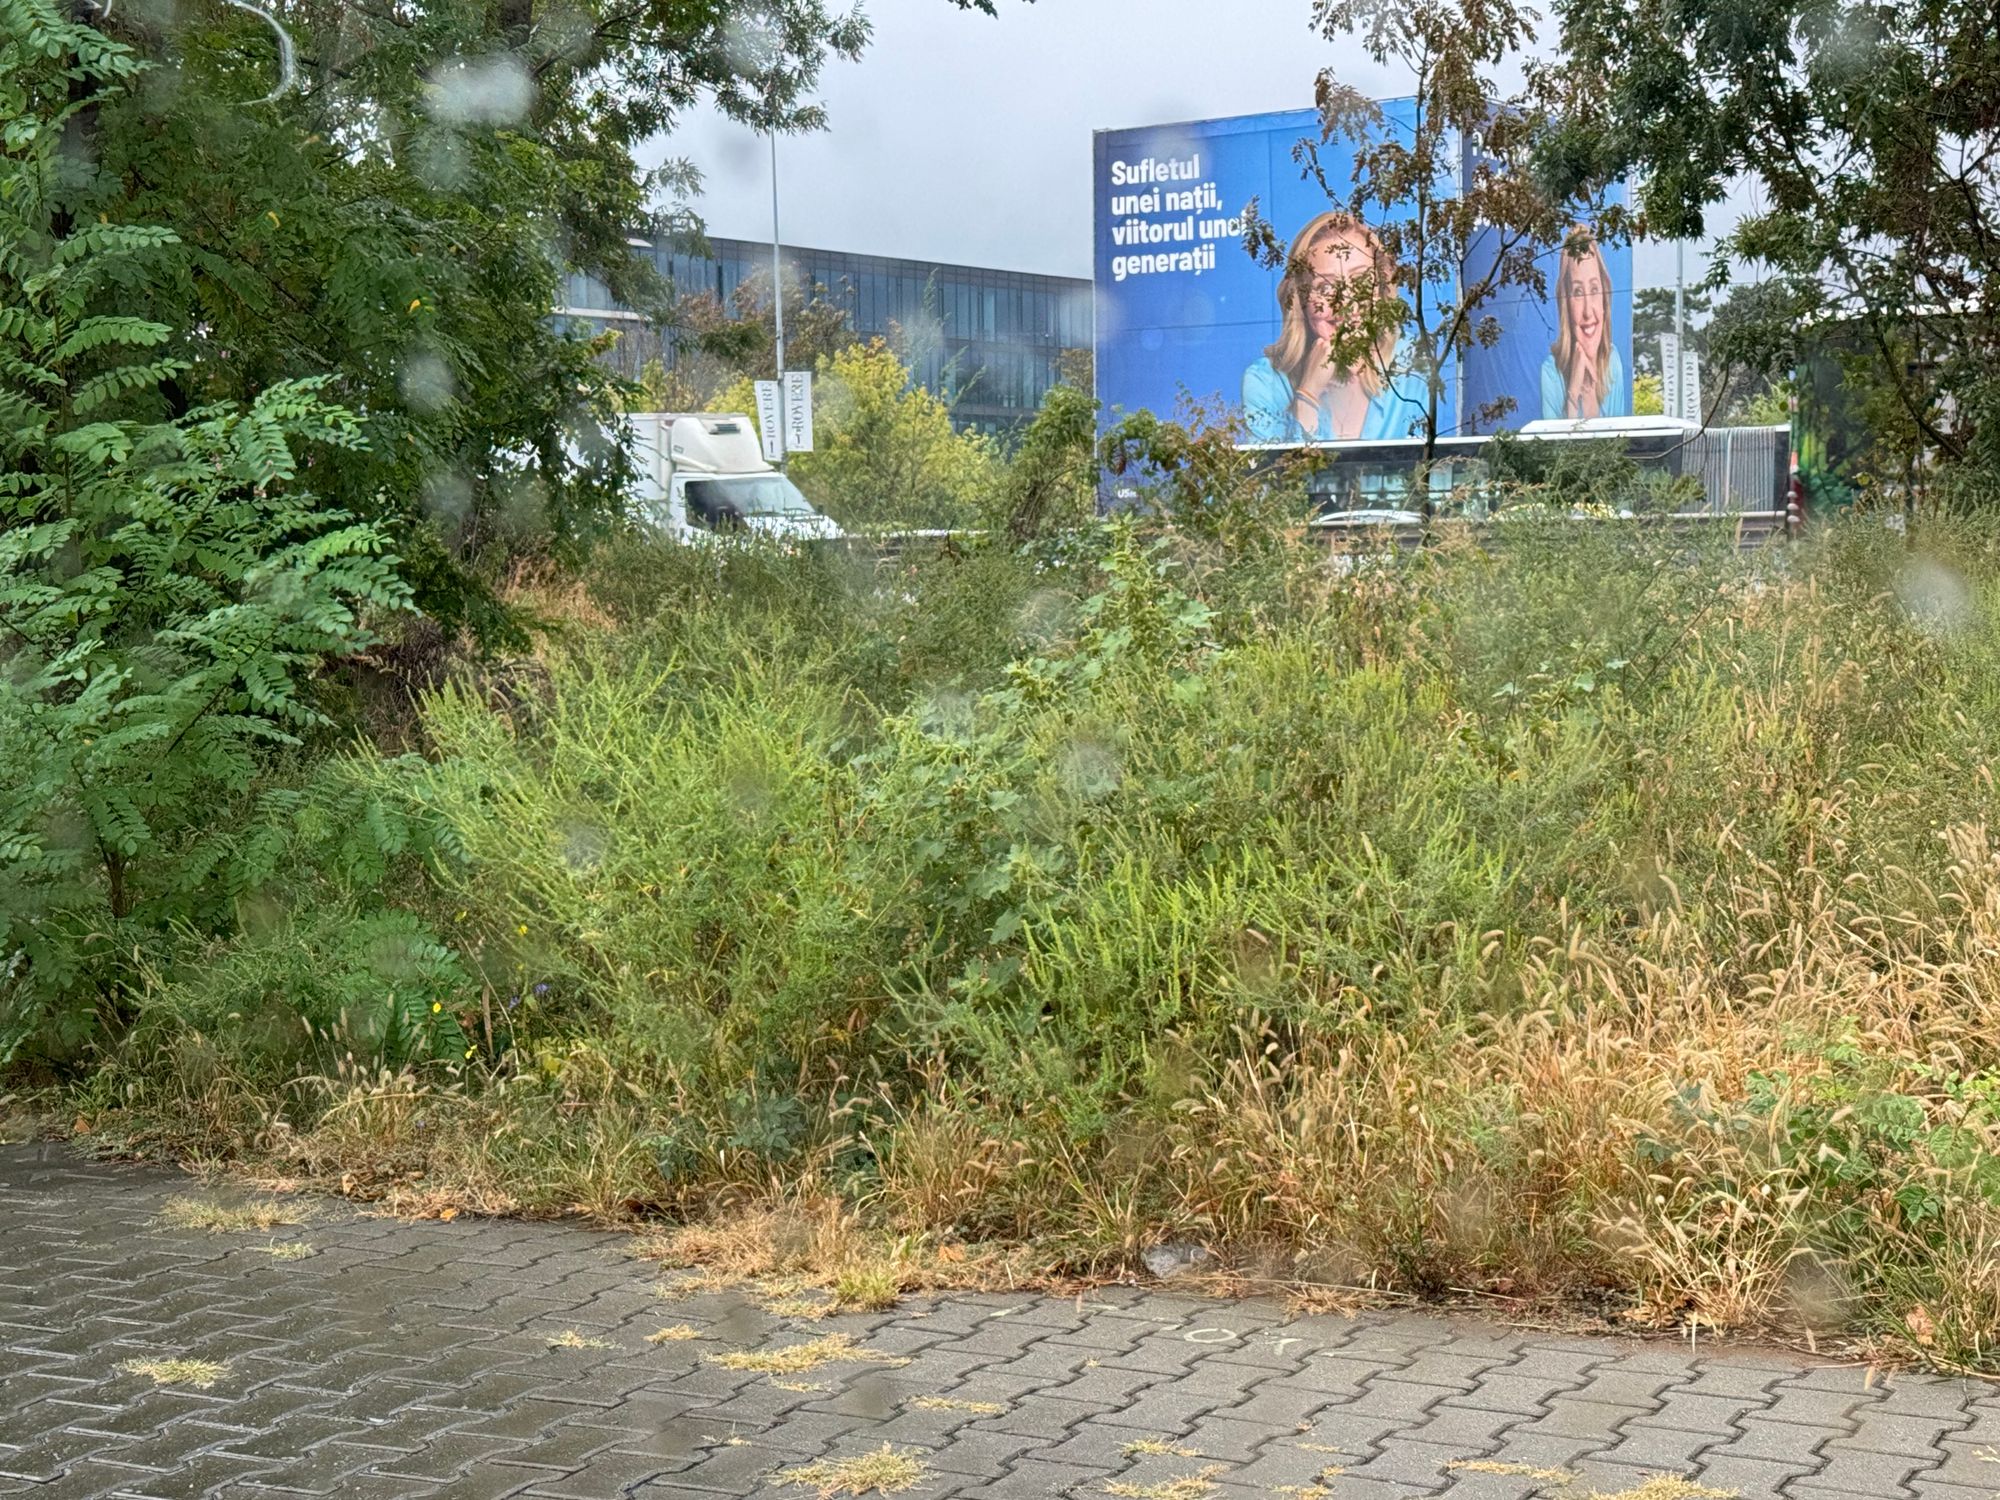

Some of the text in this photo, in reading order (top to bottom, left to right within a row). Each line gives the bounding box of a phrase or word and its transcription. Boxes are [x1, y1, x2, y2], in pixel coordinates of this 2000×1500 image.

[1111, 154, 1200, 185] Sufletul
[1111, 182, 1223, 215] unei nații,
[1111, 215, 1194, 245] viitorul
[1111, 243, 1216, 281] generații
